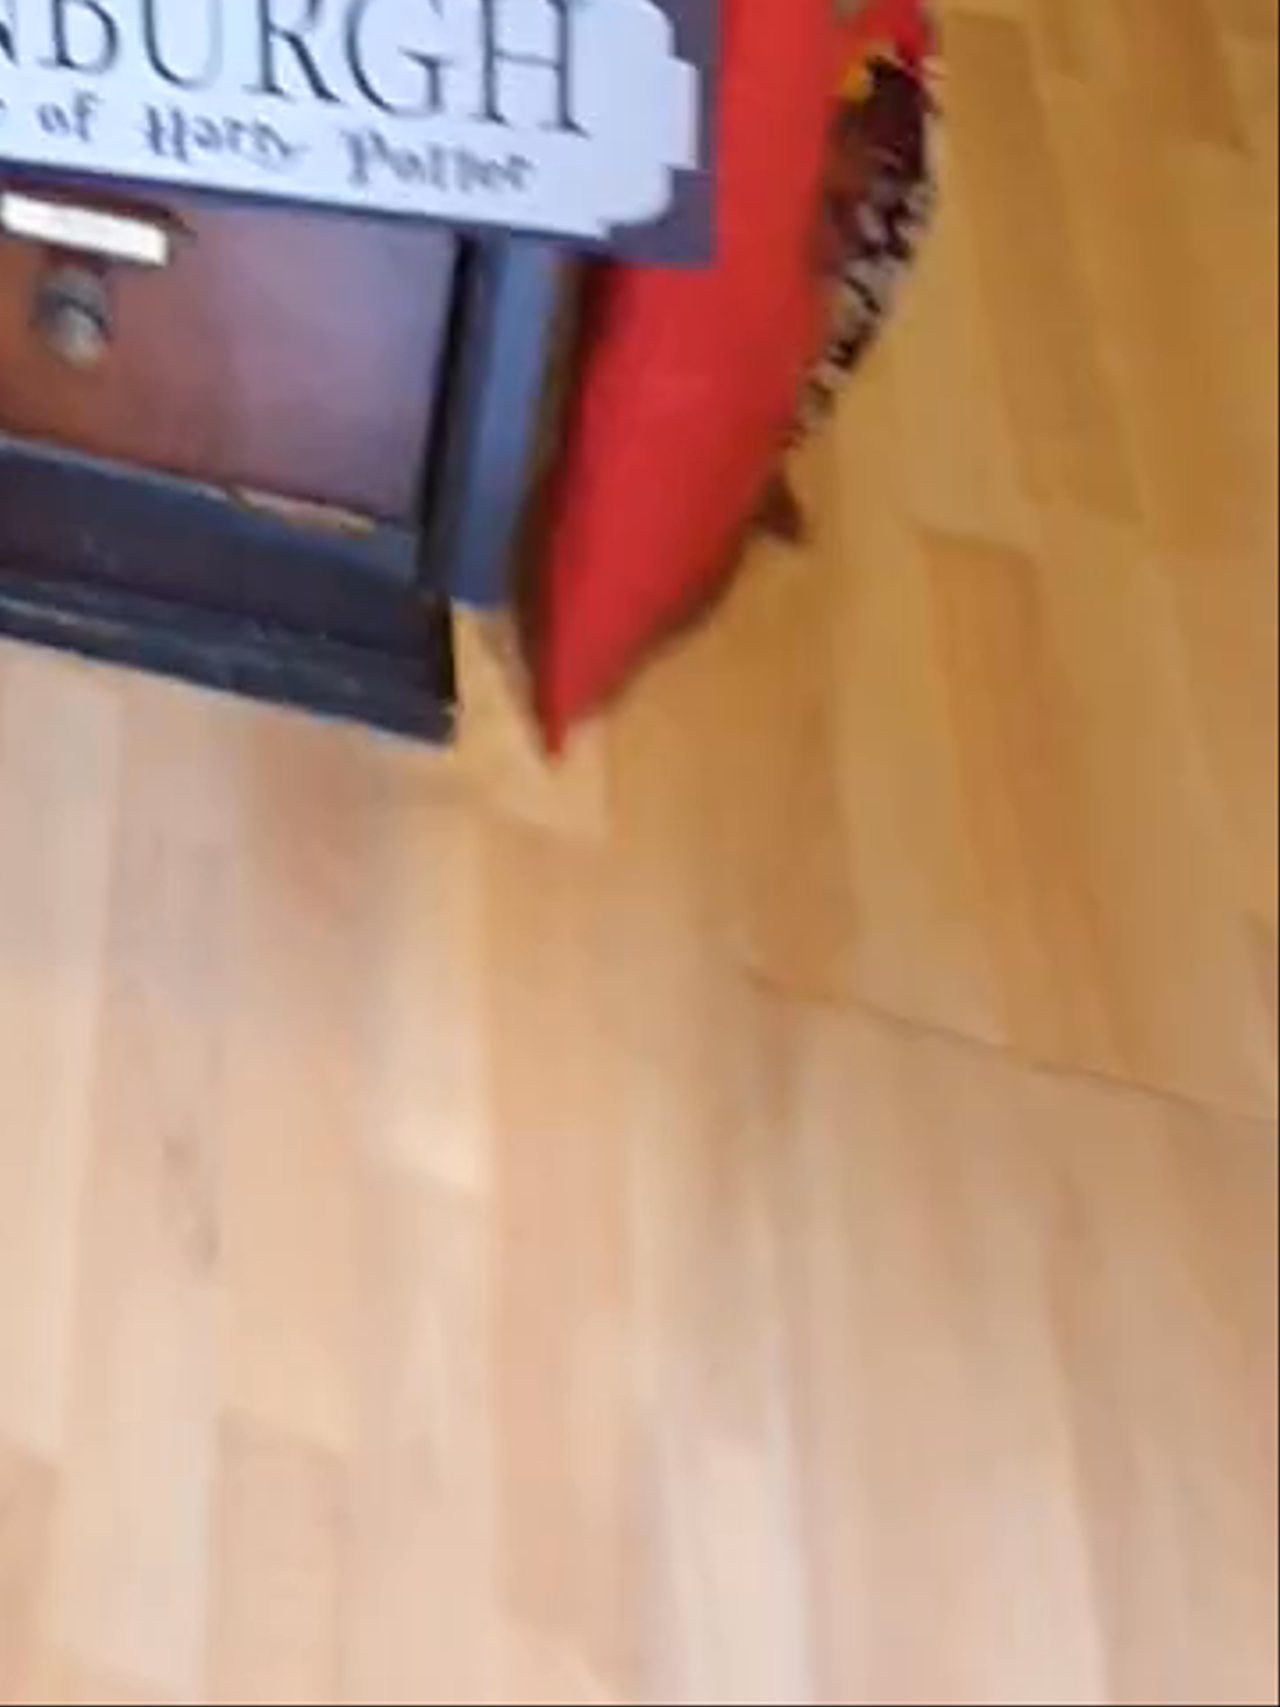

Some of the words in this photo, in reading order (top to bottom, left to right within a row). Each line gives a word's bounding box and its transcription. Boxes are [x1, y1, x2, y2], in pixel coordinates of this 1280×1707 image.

[37, 92, 102, 143] of
[142, 101, 308, 173] Harry
[341, 127, 534, 193] Potter
